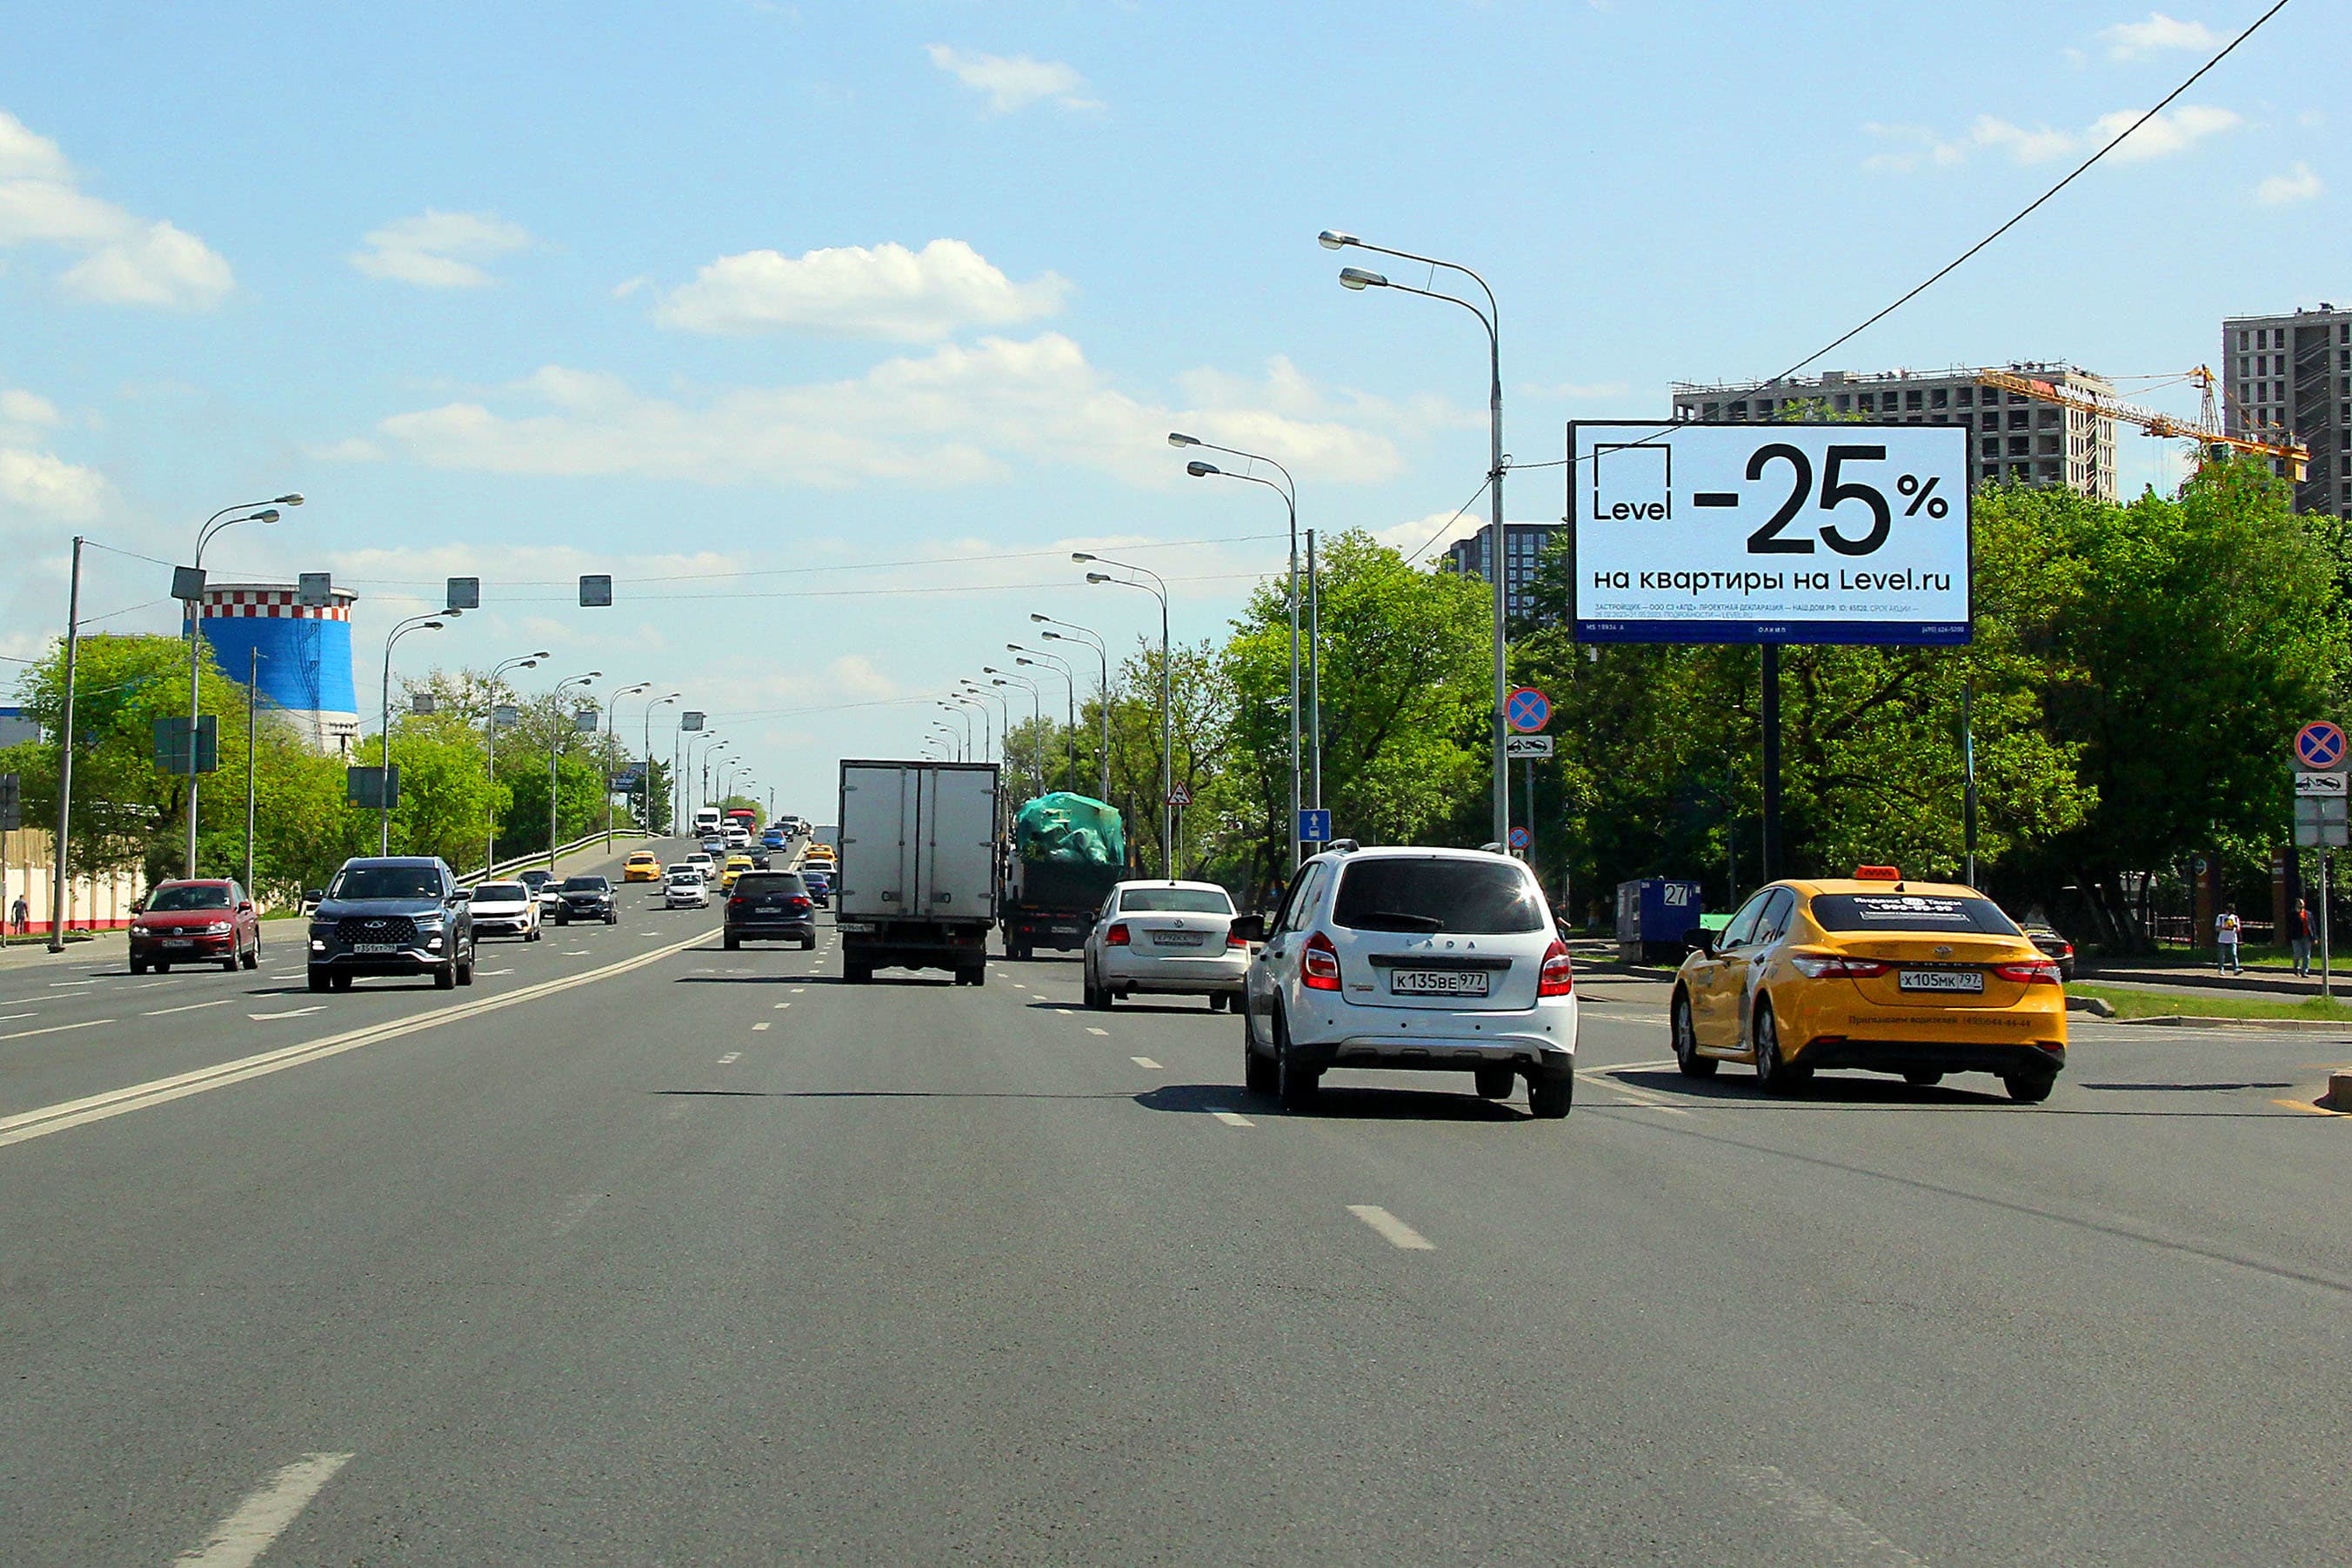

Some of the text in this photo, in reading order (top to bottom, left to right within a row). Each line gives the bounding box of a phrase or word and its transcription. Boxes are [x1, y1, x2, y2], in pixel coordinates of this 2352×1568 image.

[1594, 490, 1671, 520] Level
[1594, 568, 1950, 596] на квартиры на Level.ru
[1665, 884, 1687, 904] 27
[1406, 939, 1476, 951] LADA
